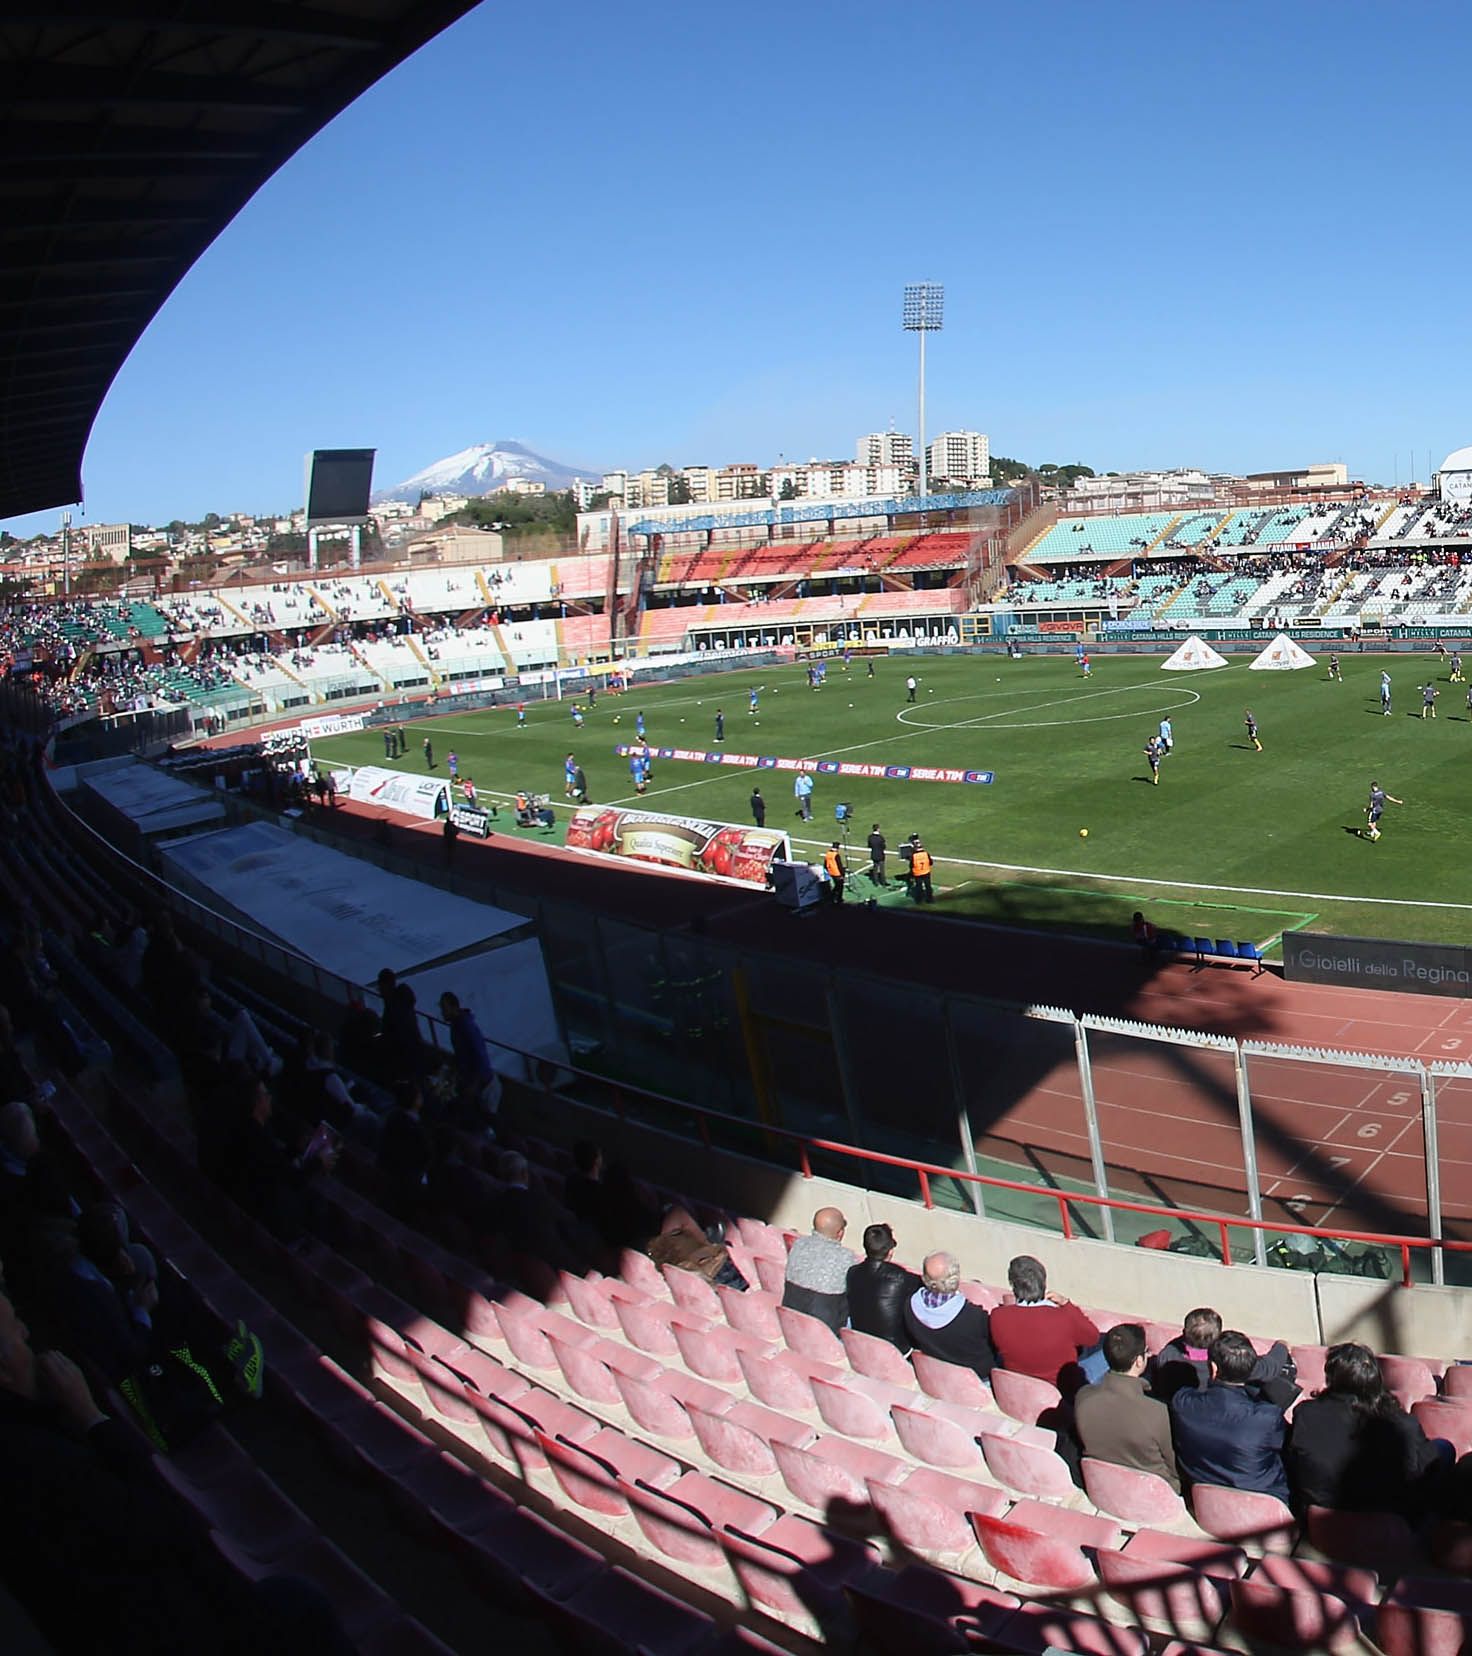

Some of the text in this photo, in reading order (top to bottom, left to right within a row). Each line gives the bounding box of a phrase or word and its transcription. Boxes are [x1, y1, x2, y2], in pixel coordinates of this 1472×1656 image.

[849, 625, 958, 641] CATANIA
[1301, 630, 1338, 639] RESIDENCE
[1439, 629, 1471, 637] CATANIA
[917, 635, 959, 647] GRAFFIO
[809, 649, 840, 659] SPORT
[840, 763, 862, 774] SERIE
[869, 765, 885, 777] TIM
[912, 767, 936, 779] SERIE
[936, 768, 944, 780] A
[945, 770, 964, 782] TIM
[1299, 950, 1360, 973] Gioielli
[1365, 963, 1398, 977] della
[1403, 959, 1470, 984] Regina
[1441, 1038, 1463, 1050] 3
[1386, 1091, 1411, 1106] 5
[1357, 1123, 1382, 1138] 6
[1327, 1156, 1352, 1173] 7
